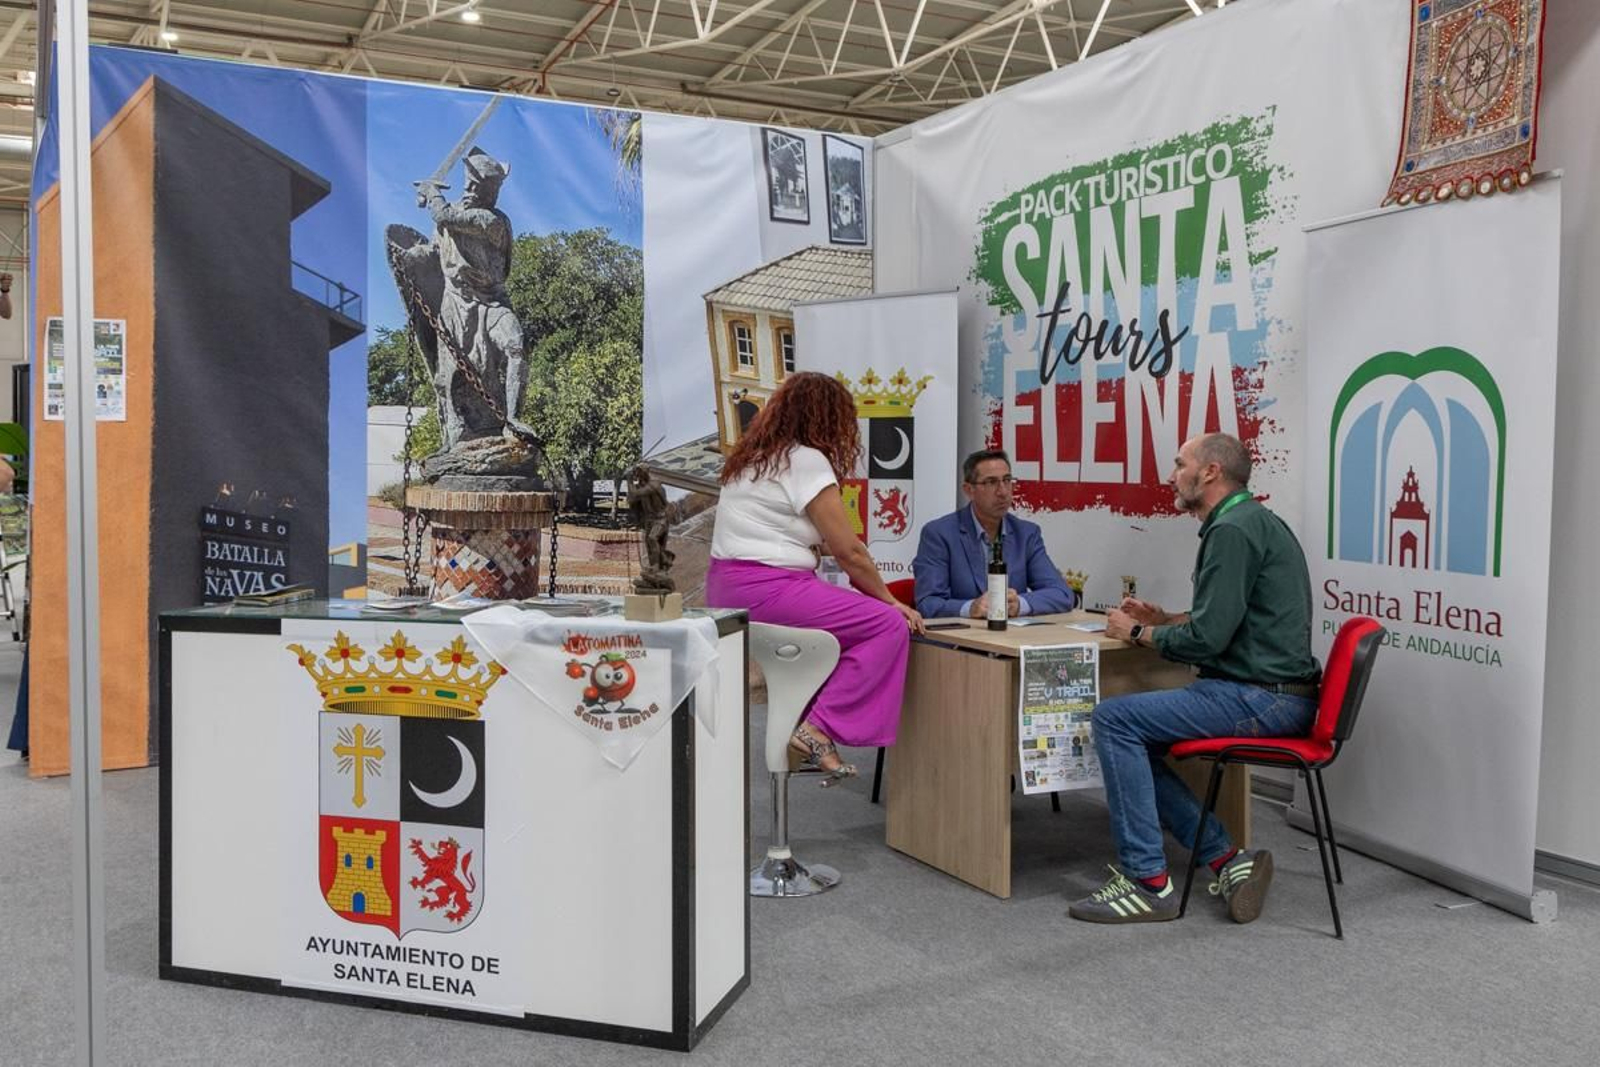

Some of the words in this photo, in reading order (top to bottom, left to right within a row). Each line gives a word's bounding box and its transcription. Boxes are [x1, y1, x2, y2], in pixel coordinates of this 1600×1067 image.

[1019, 185, 1084, 222] PACK
[1084, 142, 1235, 205] TURÍSTICO
[1002, 176, 1257, 354] SANTA
[1036, 281, 1189, 385] tours
[1002, 332, 1241, 484] ELENA
[205, 512, 286, 535] MUSEO
[205, 541, 286, 567] BATALLA
[204, 569, 286, 597] NAVAS
[1323, 579, 1402, 621] Santa
[1413, 590, 1504, 637] Elena
[586, 634, 643, 650] TOMATINA
[624, 650, 647, 659] 2024
[1379, 631, 1401, 649] DE
[1405, 634, 1502, 667] ANDALUCÍA
[574, 705, 613, 731] Santa
[618, 702, 659, 729] Elena
[306, 936, 464, 970] AYUNTAMIENTO
[471, 956, 500, 974] DE
[334, 963, 400, 986] SANTA
[406, 972, 476, 996] ELENA
